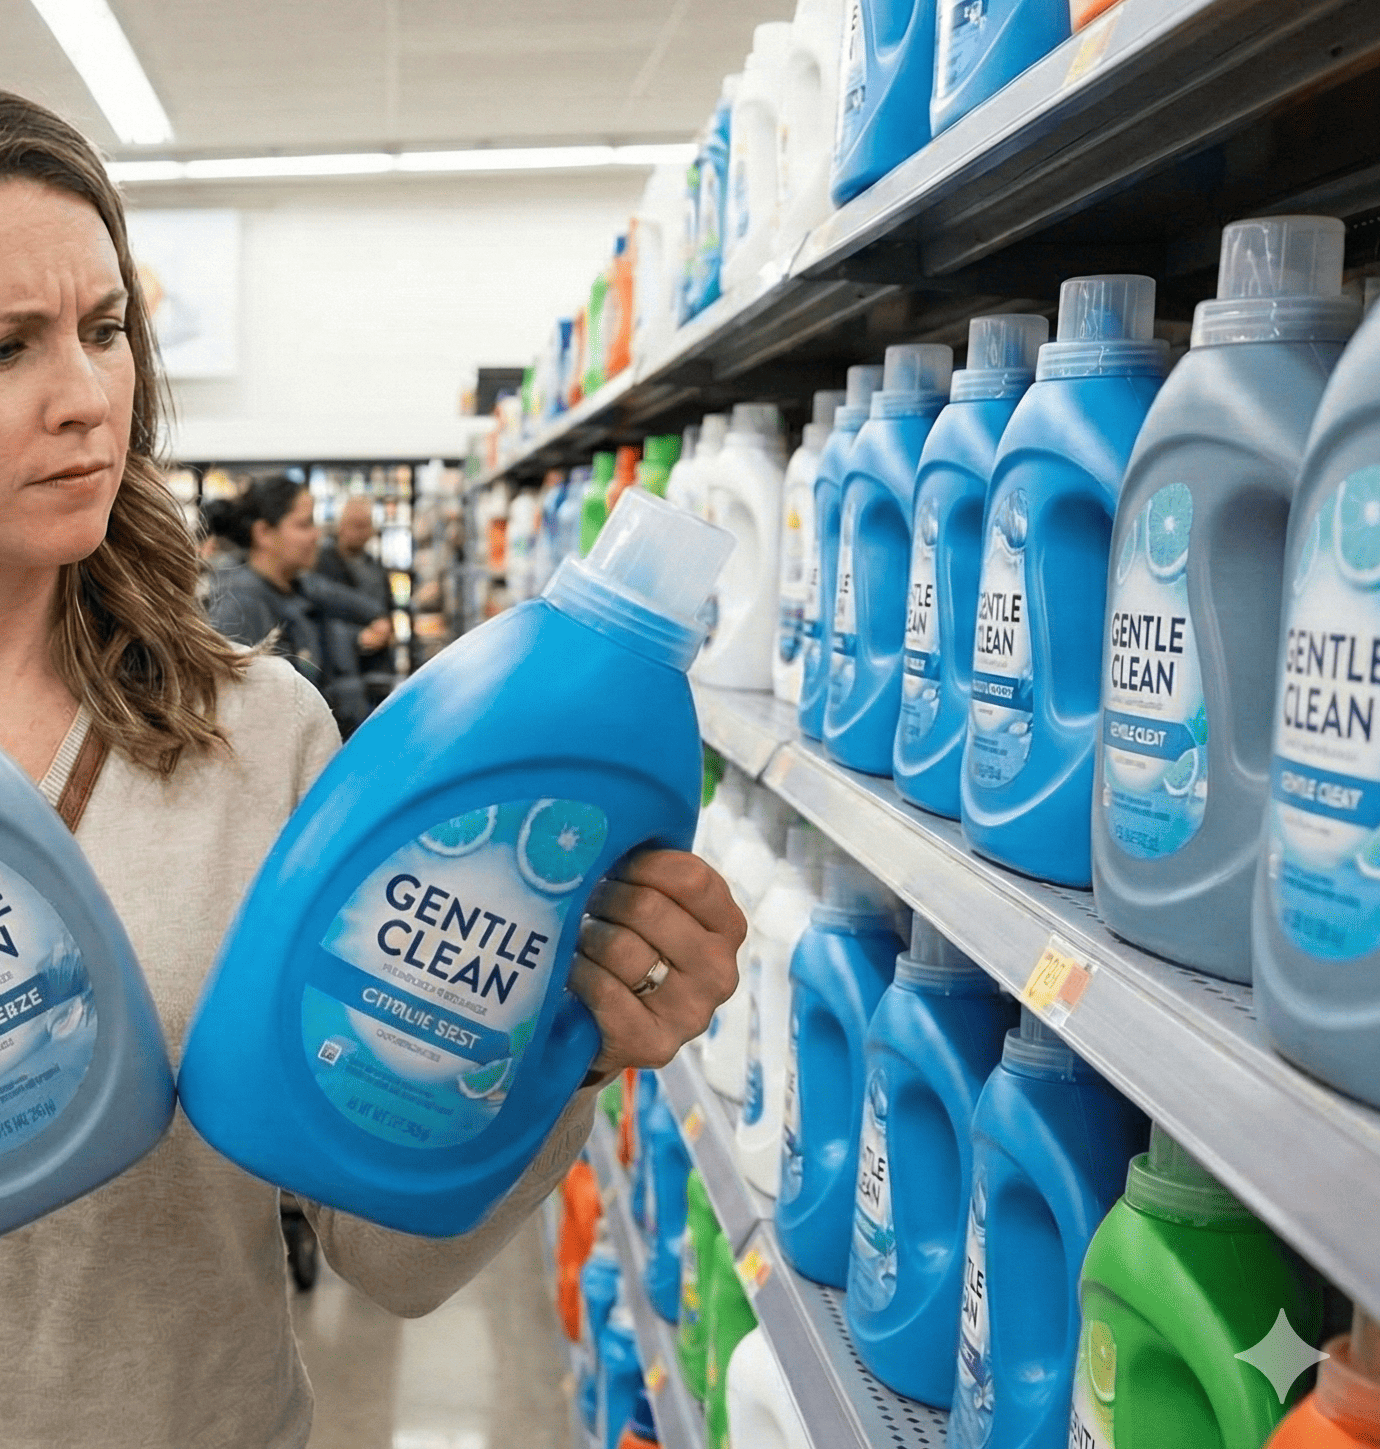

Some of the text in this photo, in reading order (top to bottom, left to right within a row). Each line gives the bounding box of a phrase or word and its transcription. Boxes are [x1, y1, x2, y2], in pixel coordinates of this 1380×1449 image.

[1111, 612, 1186, 654] GENTLE
[1111, 653, 1175, 697] CLEAN
[1284, 683, 1374, 743] CLEAN
[385, 873, 549, 970] GENTLE
[377, 919, 520, 1005] CLEAN
